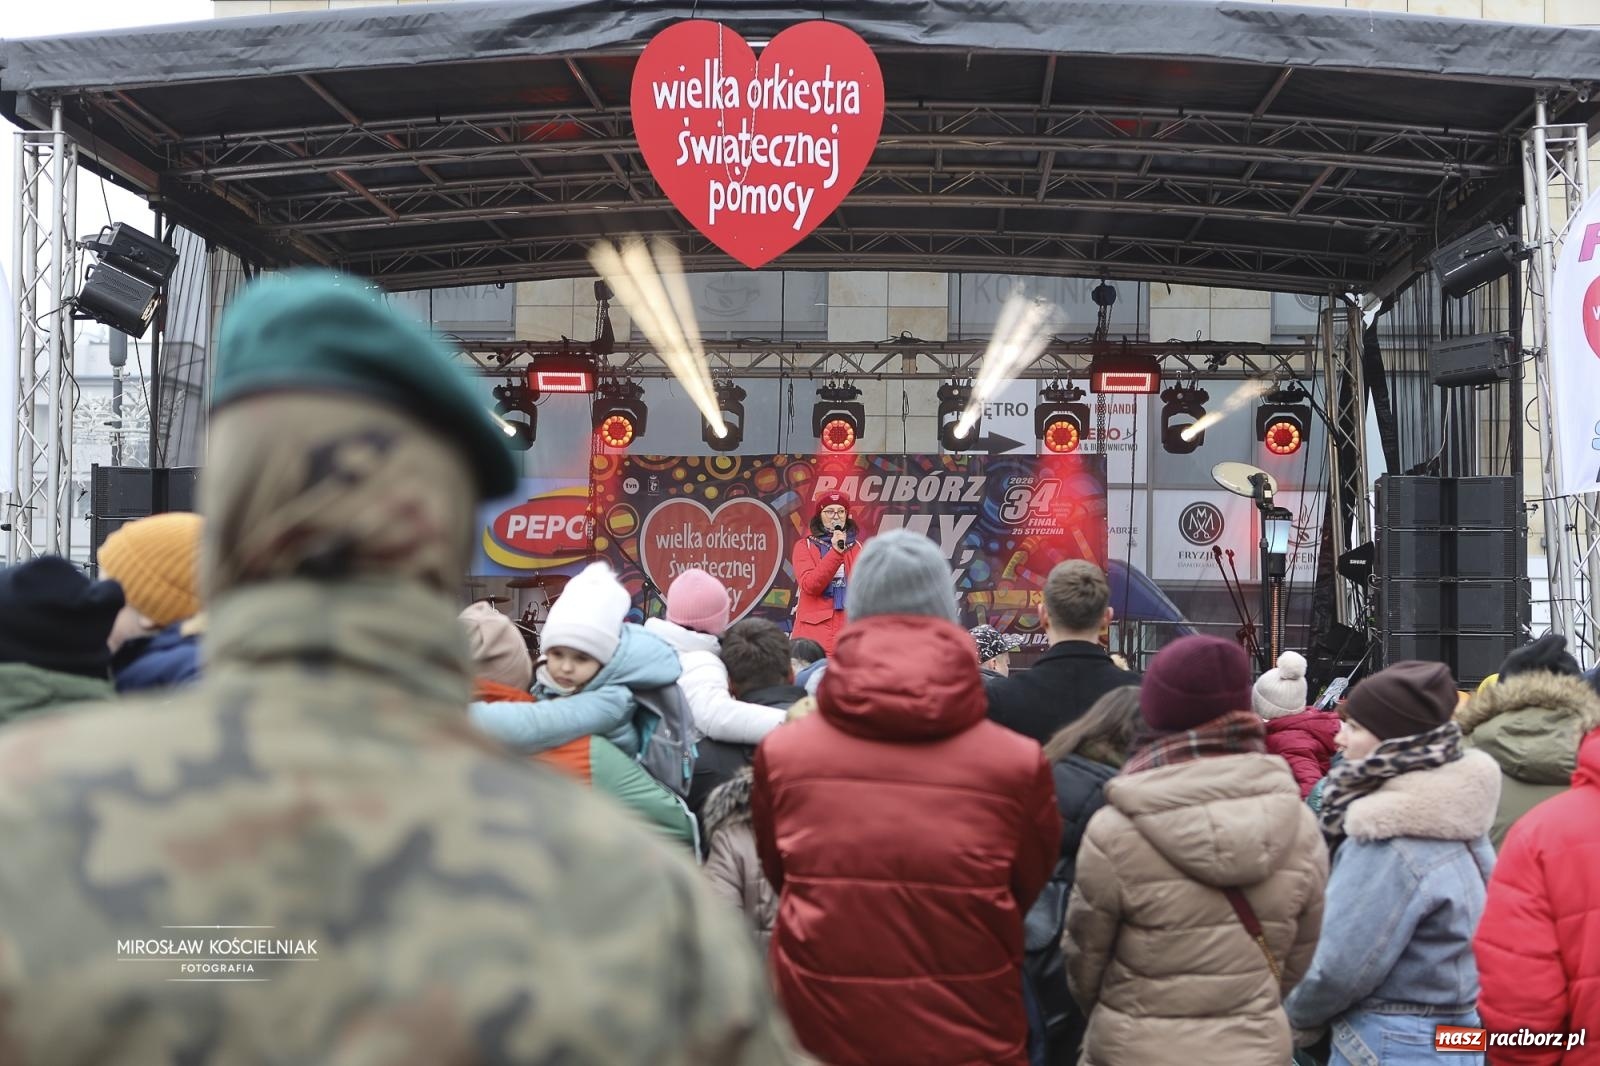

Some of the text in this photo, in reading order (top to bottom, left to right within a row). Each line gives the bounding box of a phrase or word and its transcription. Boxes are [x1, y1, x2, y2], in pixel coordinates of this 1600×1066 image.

[653, 58, 860, 115] wielka orkiestra
[676, 117, 839, 189] świątecznej
[708, 179, 815, 231] pomocy
[981, 402, 1029, 420] ĘTRO
[1090, 443, 1138, 452] BWNICTWO
[812, 471, 987, 503] RACIBÓRZ
[1009, 477, 1034, 485] 2026
[1003, 482, 1058, 520] 34
[656, 522, 767, 551] wielka orkiestra
[1025, 528, 1065, 536] STYCZNIA
[1108, 526, 1139, 535] ABRZE
